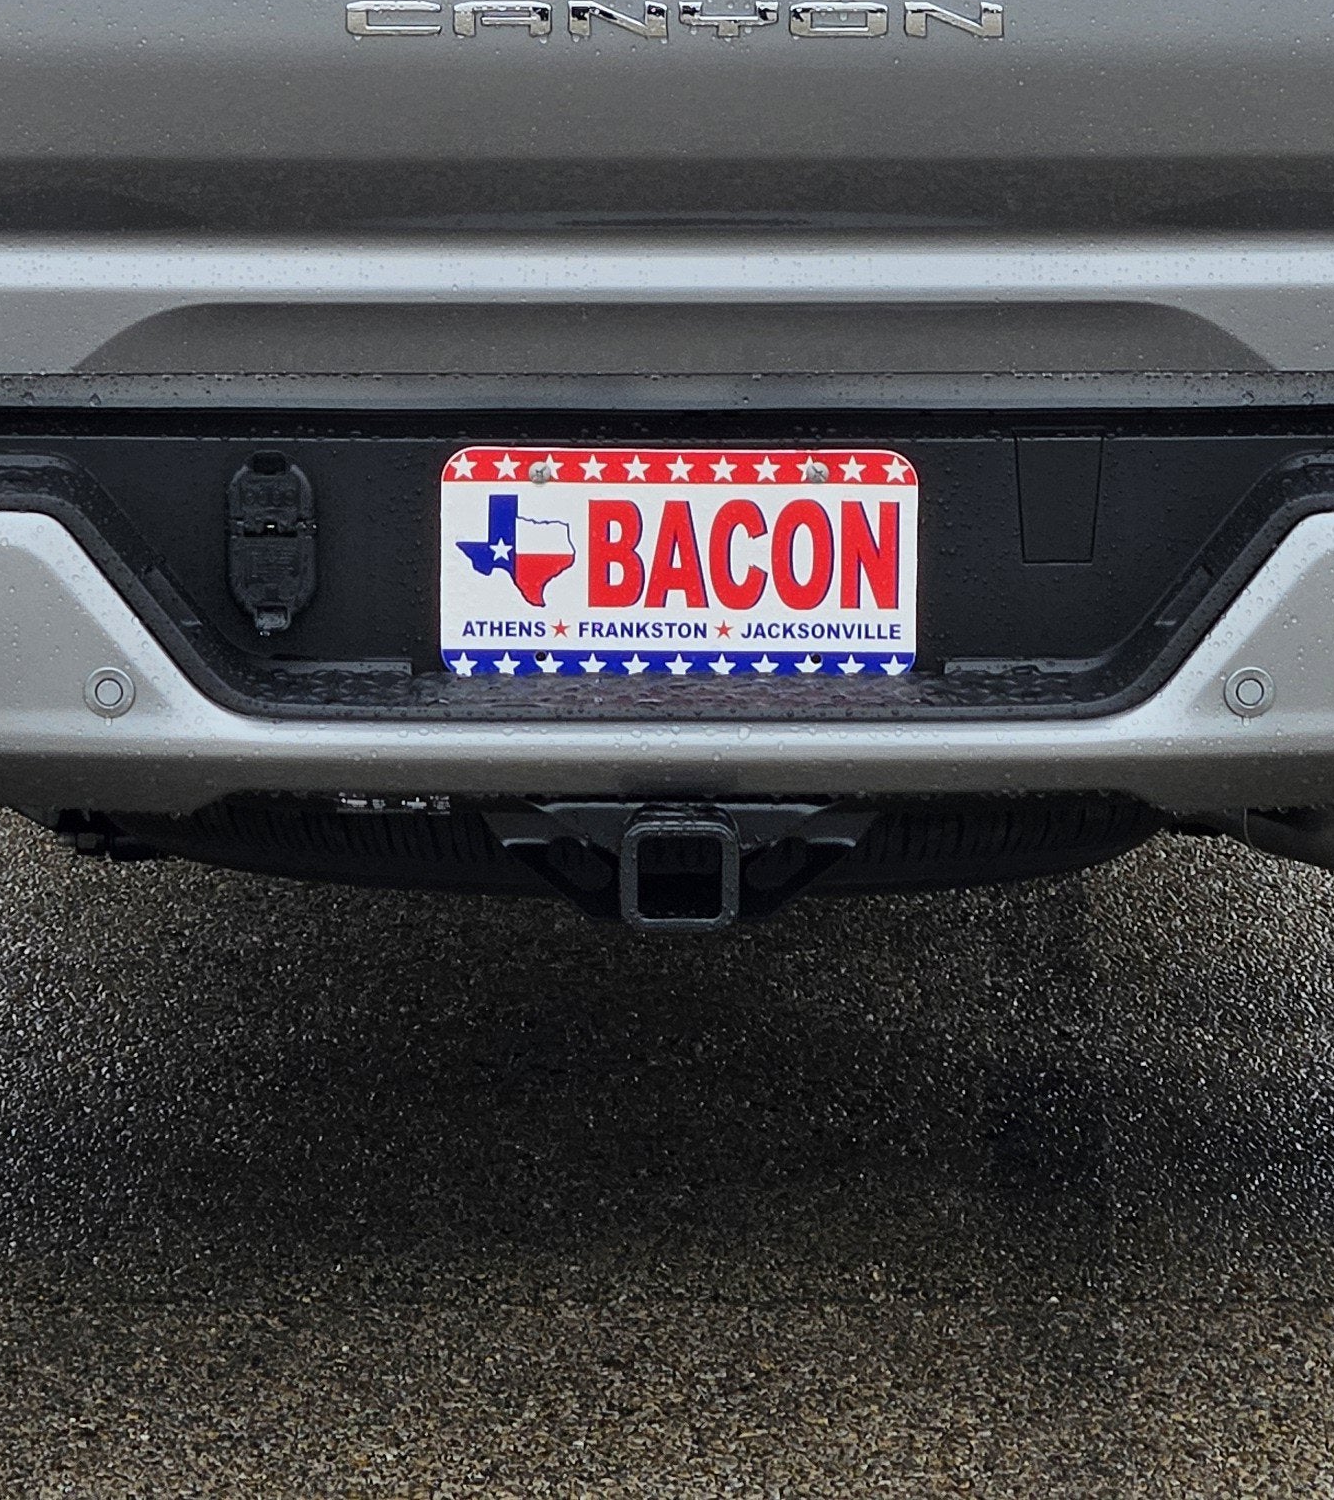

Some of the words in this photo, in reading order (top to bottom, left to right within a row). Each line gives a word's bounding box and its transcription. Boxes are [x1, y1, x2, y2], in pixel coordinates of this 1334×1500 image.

[344, 0, 1006, 39] CANYON
[587, 498, 901, 611] BACON
[461, 619, 547, 638] ATHENS
[578, 621, 708, 640] FRANKSTON
[740, 621, 902, 641] JACKSONVILLE
